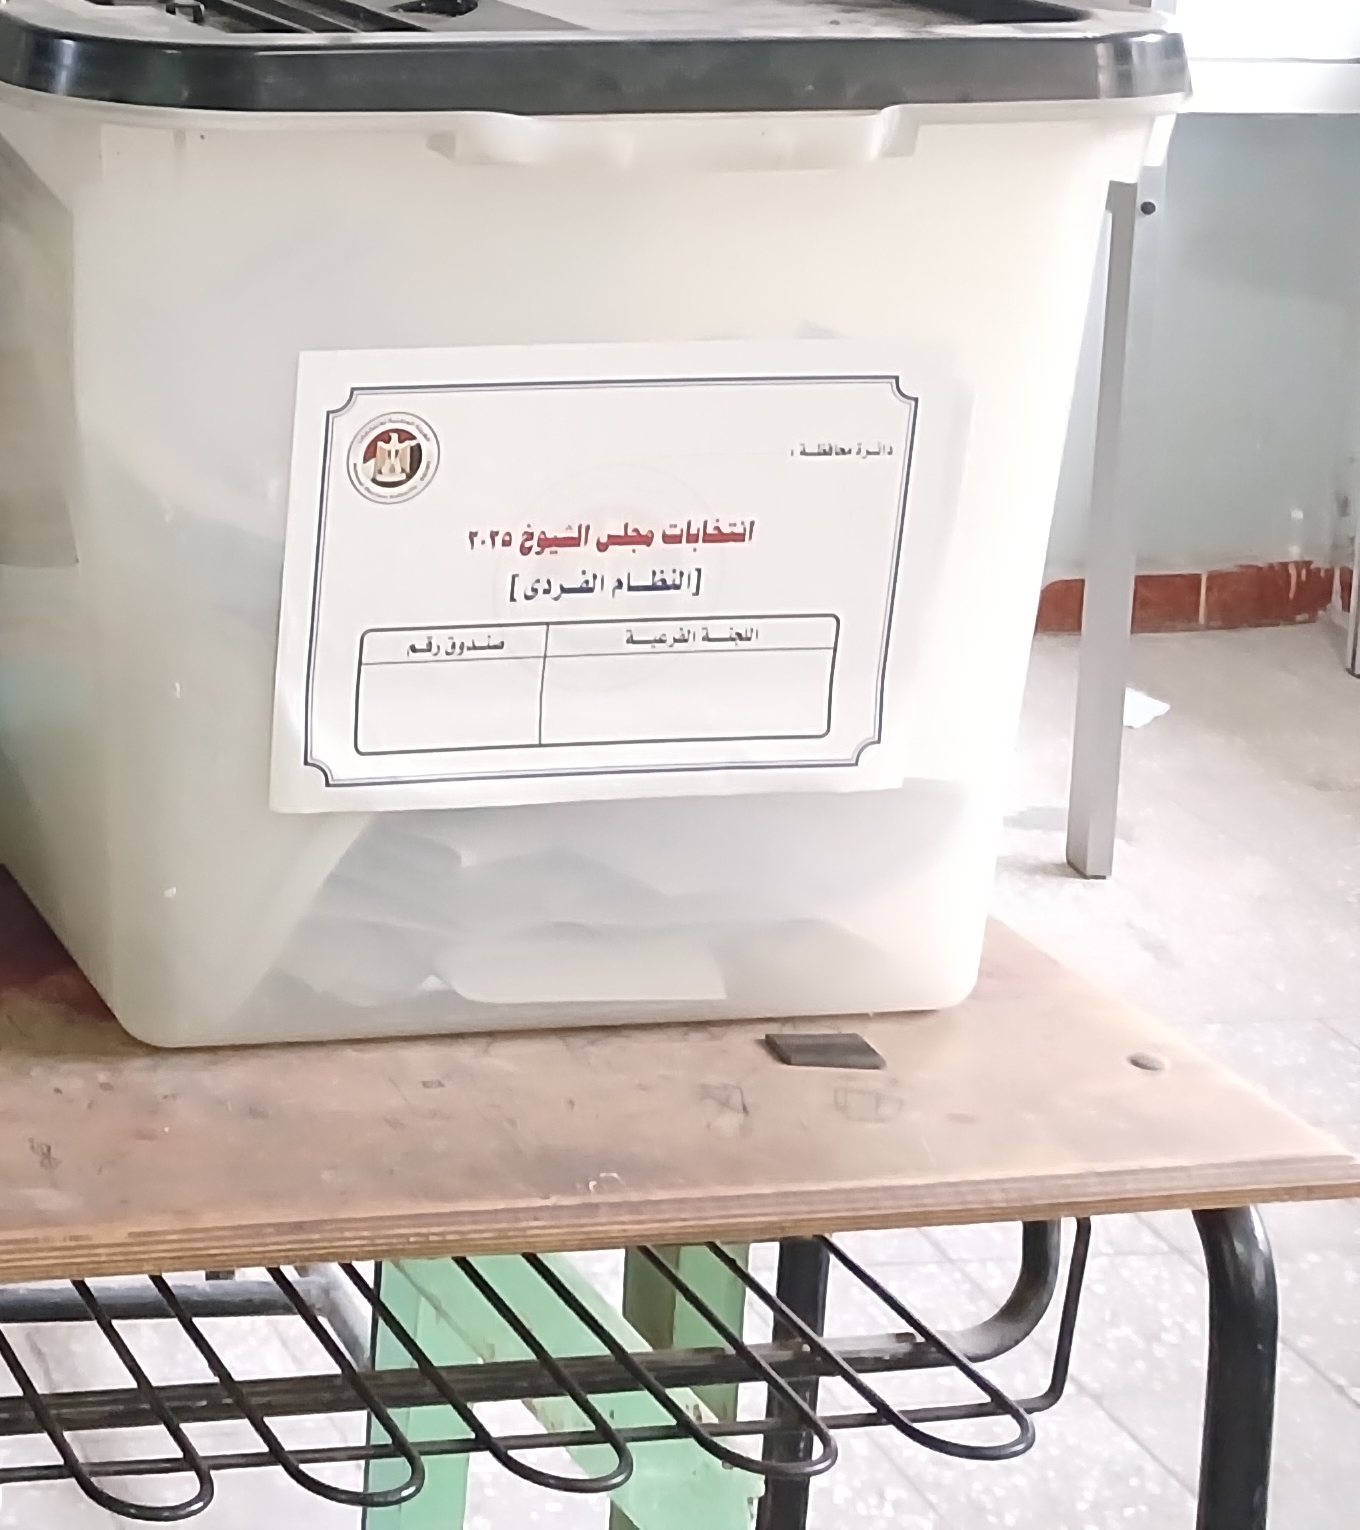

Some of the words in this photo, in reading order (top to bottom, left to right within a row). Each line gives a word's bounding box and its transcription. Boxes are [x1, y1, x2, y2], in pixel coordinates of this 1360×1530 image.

[467, 529, 513, 551] ٢٠٢٥
[518, 522, 591, 557] الشيوخ
[595, 521, 655, 554] مجلس
[660, 518, 756, 553] انتخابات
[406, 636, 441, 657] رقم
[443, 634, 505, 656] صندوق
[625, 628, 697, 649] الفرعية
[700, 627, 760, 647] اللجنة
